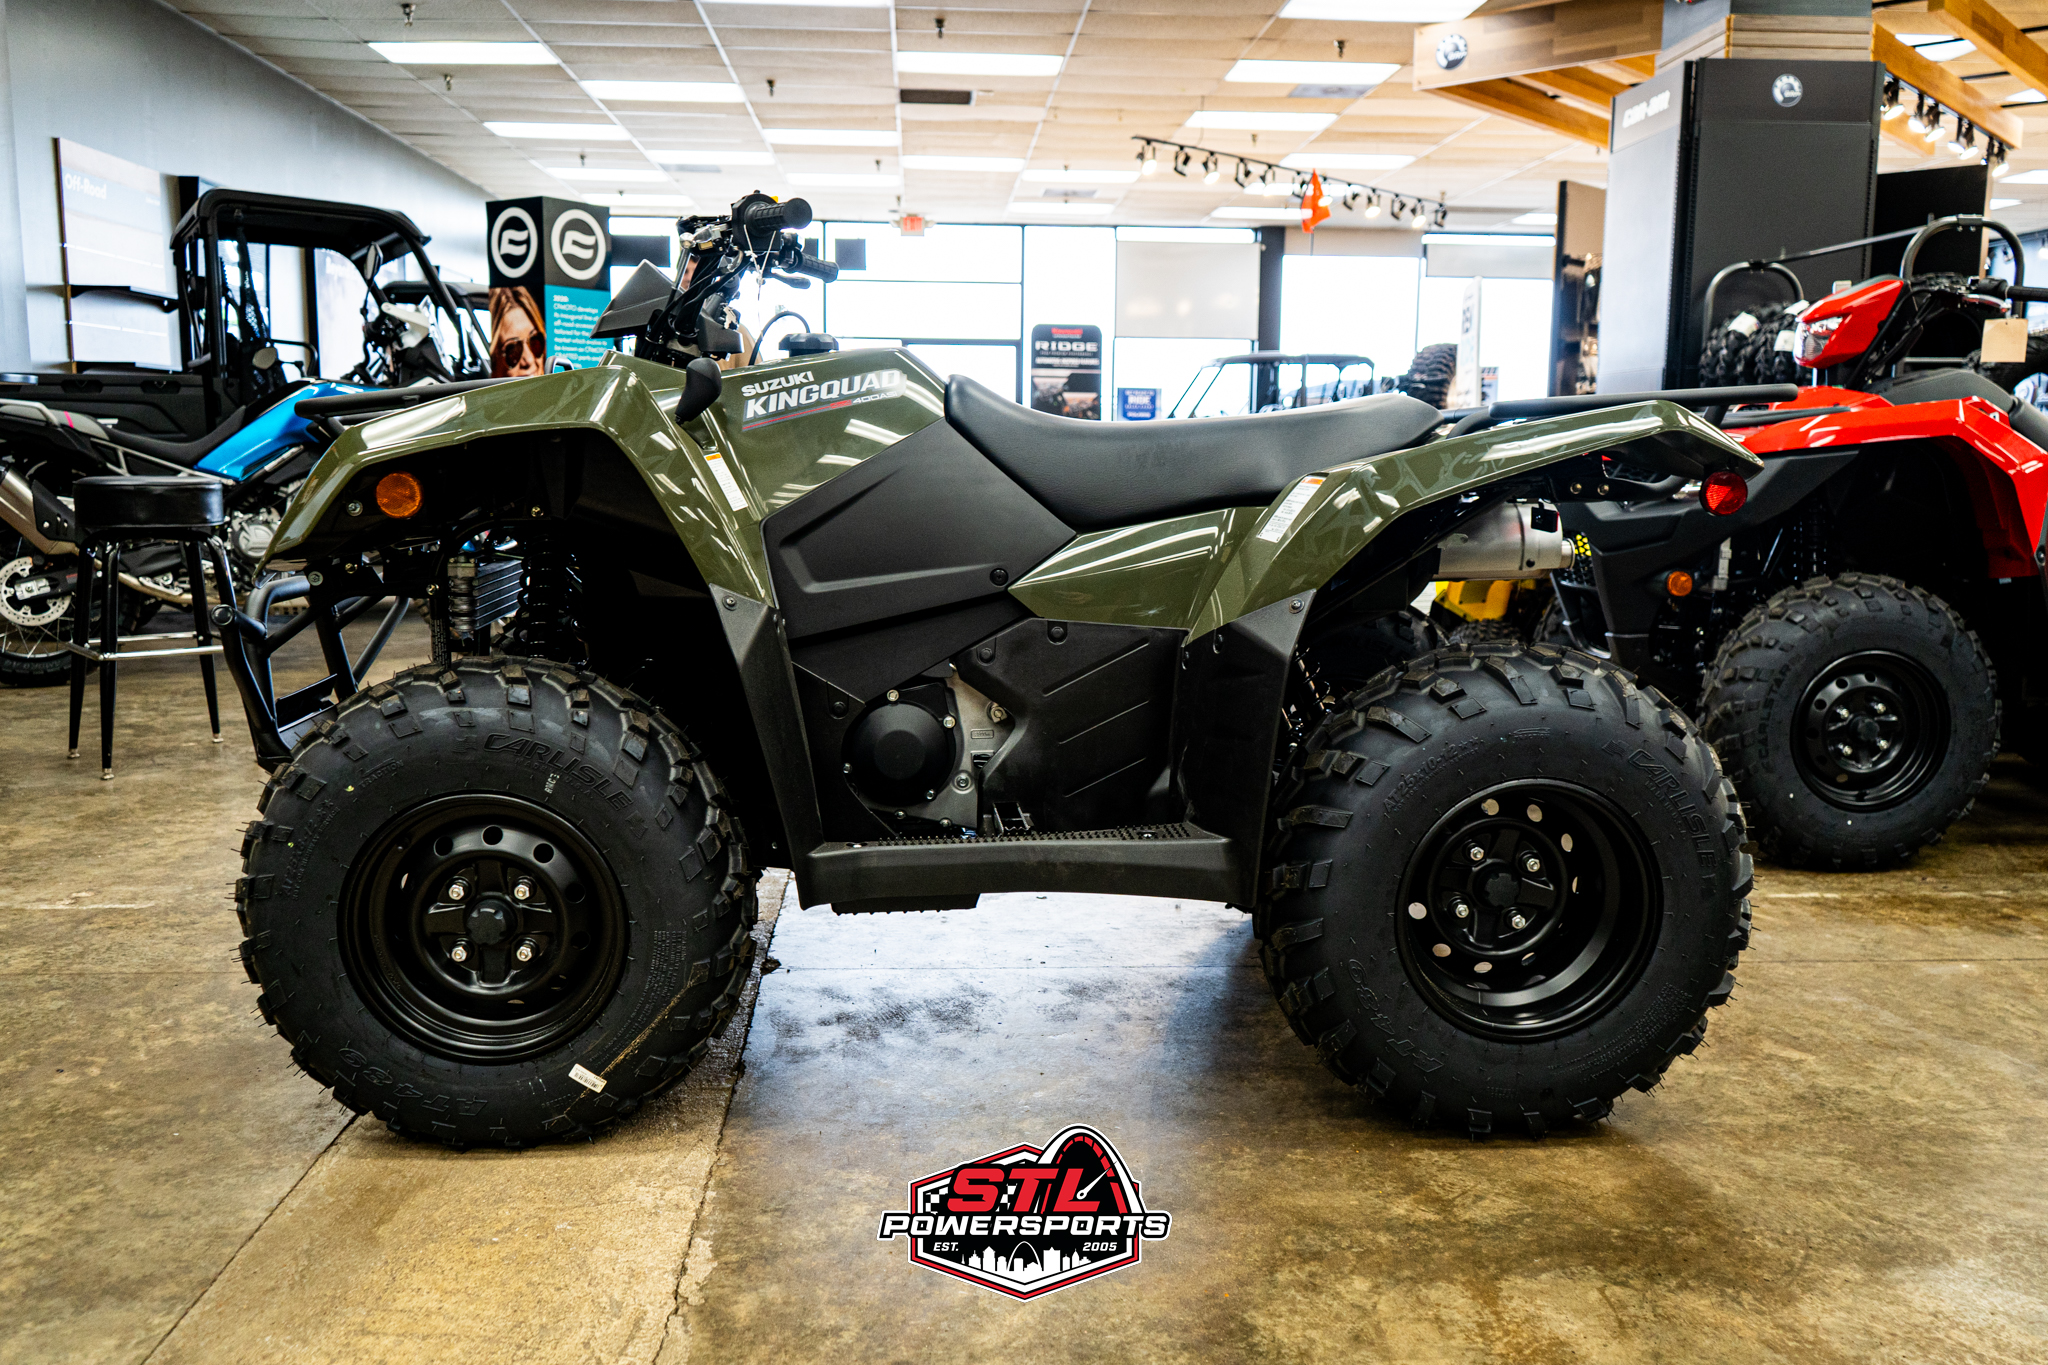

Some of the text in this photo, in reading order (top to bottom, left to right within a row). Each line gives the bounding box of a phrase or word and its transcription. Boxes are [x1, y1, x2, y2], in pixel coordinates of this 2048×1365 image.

[64, 172, 107, 200] Off-Road
[1035, 340, 1098, 352] RIDGE
[741, 371, 815, 397] SUZUKI
[745, 369, 901, 419] KINGQUAD
[483, 732, 634, 811] CARLISLE
[1627, 748, 1719, 867] CARLISLE
